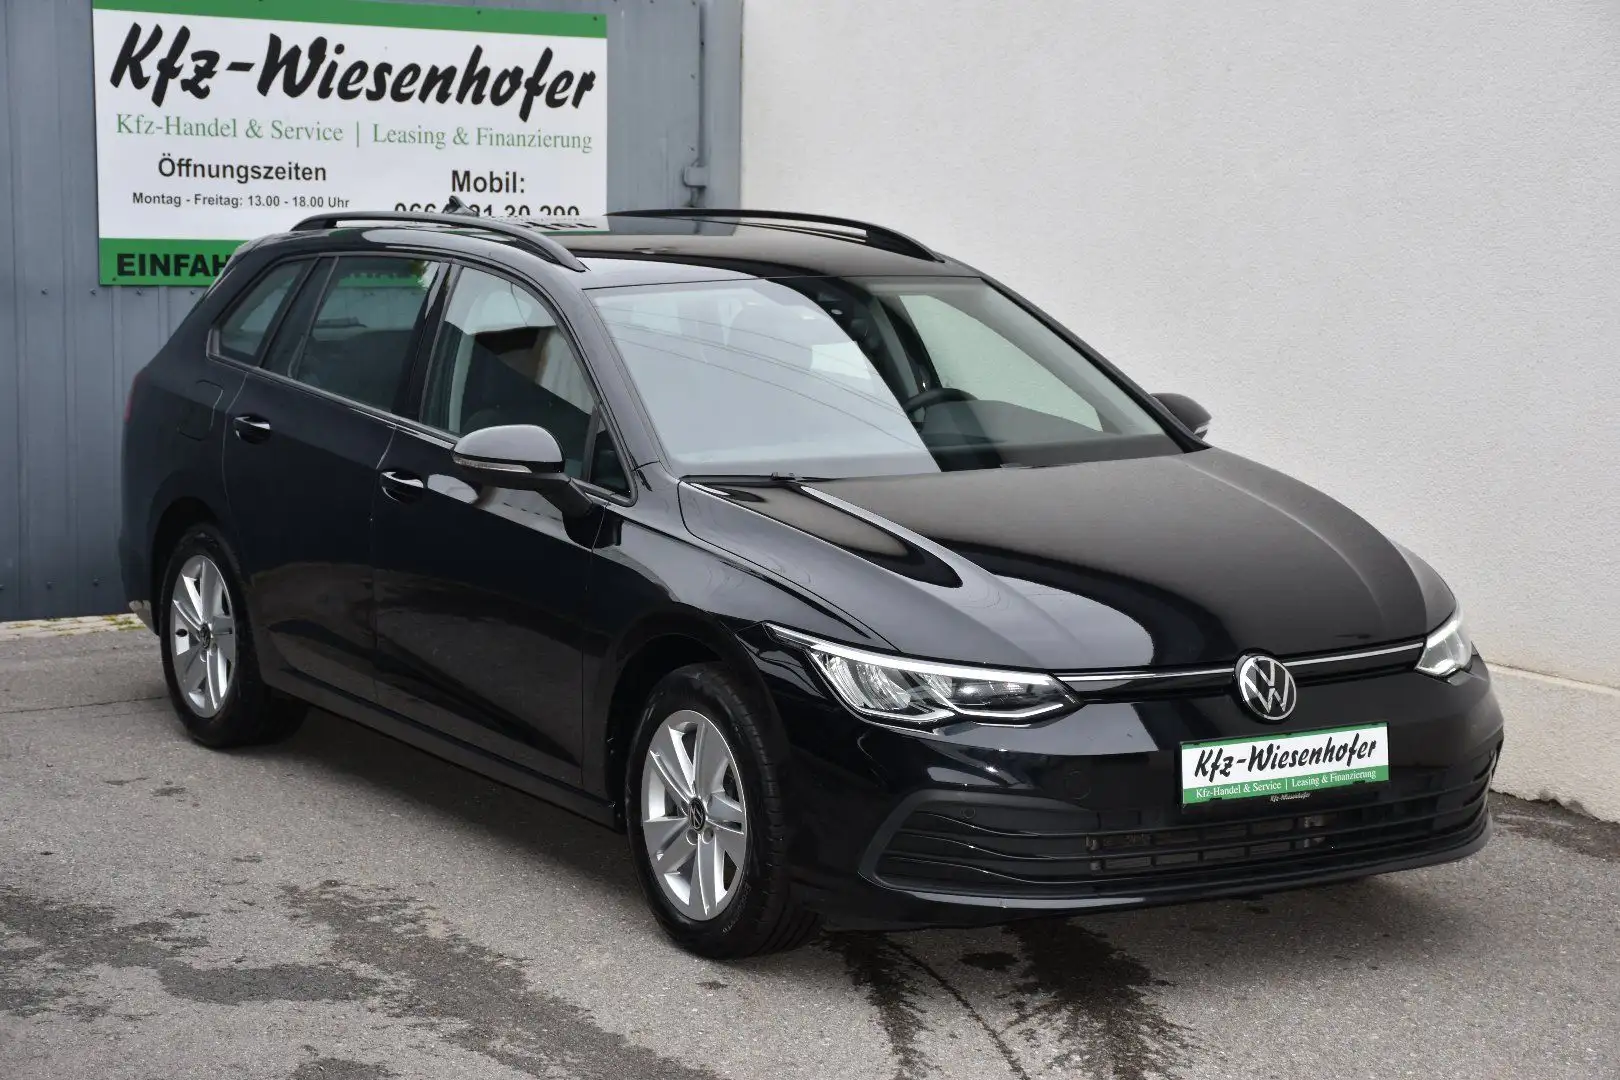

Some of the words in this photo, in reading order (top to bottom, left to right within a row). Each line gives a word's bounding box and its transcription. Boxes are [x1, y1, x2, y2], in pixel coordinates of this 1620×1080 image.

[110, 22, 597, 122] Kfz-Wiesenhofer
[116, 113, 237, 138] Kfz-Handel
[245, 119, 263, 139] &
[271, 120, 344, 141] Service
[373, 123, 446, 149] Leasing
[452, 127, 469, 145] &
[476, 127, 593, 153] Finanzierung
[158, 153, 327, 184] Öffnungszeiten
[451, 170, 525, 193] Mobil:
[132, 192, 181, 207] Montag
[194, 194, 243, 207] Freitag:
[248, 195, 280, 207] 13.00
[292, 196, 324, 207] 18.00
[328, 196, 350, 208] Uhr
[1194, 732, 1377, 783] Kfz-Wiesenhofer
[1196, 784, 1241, 798] Kfz-Handel
[1243, 783, 1251, 793] &
[1253, 780, 1282, 792] Service
[1292, 776, 1320, 787] Leasing
[1321, 774, 1328, 784] &
[1330, 770, 1376, 782] Finanzierung
